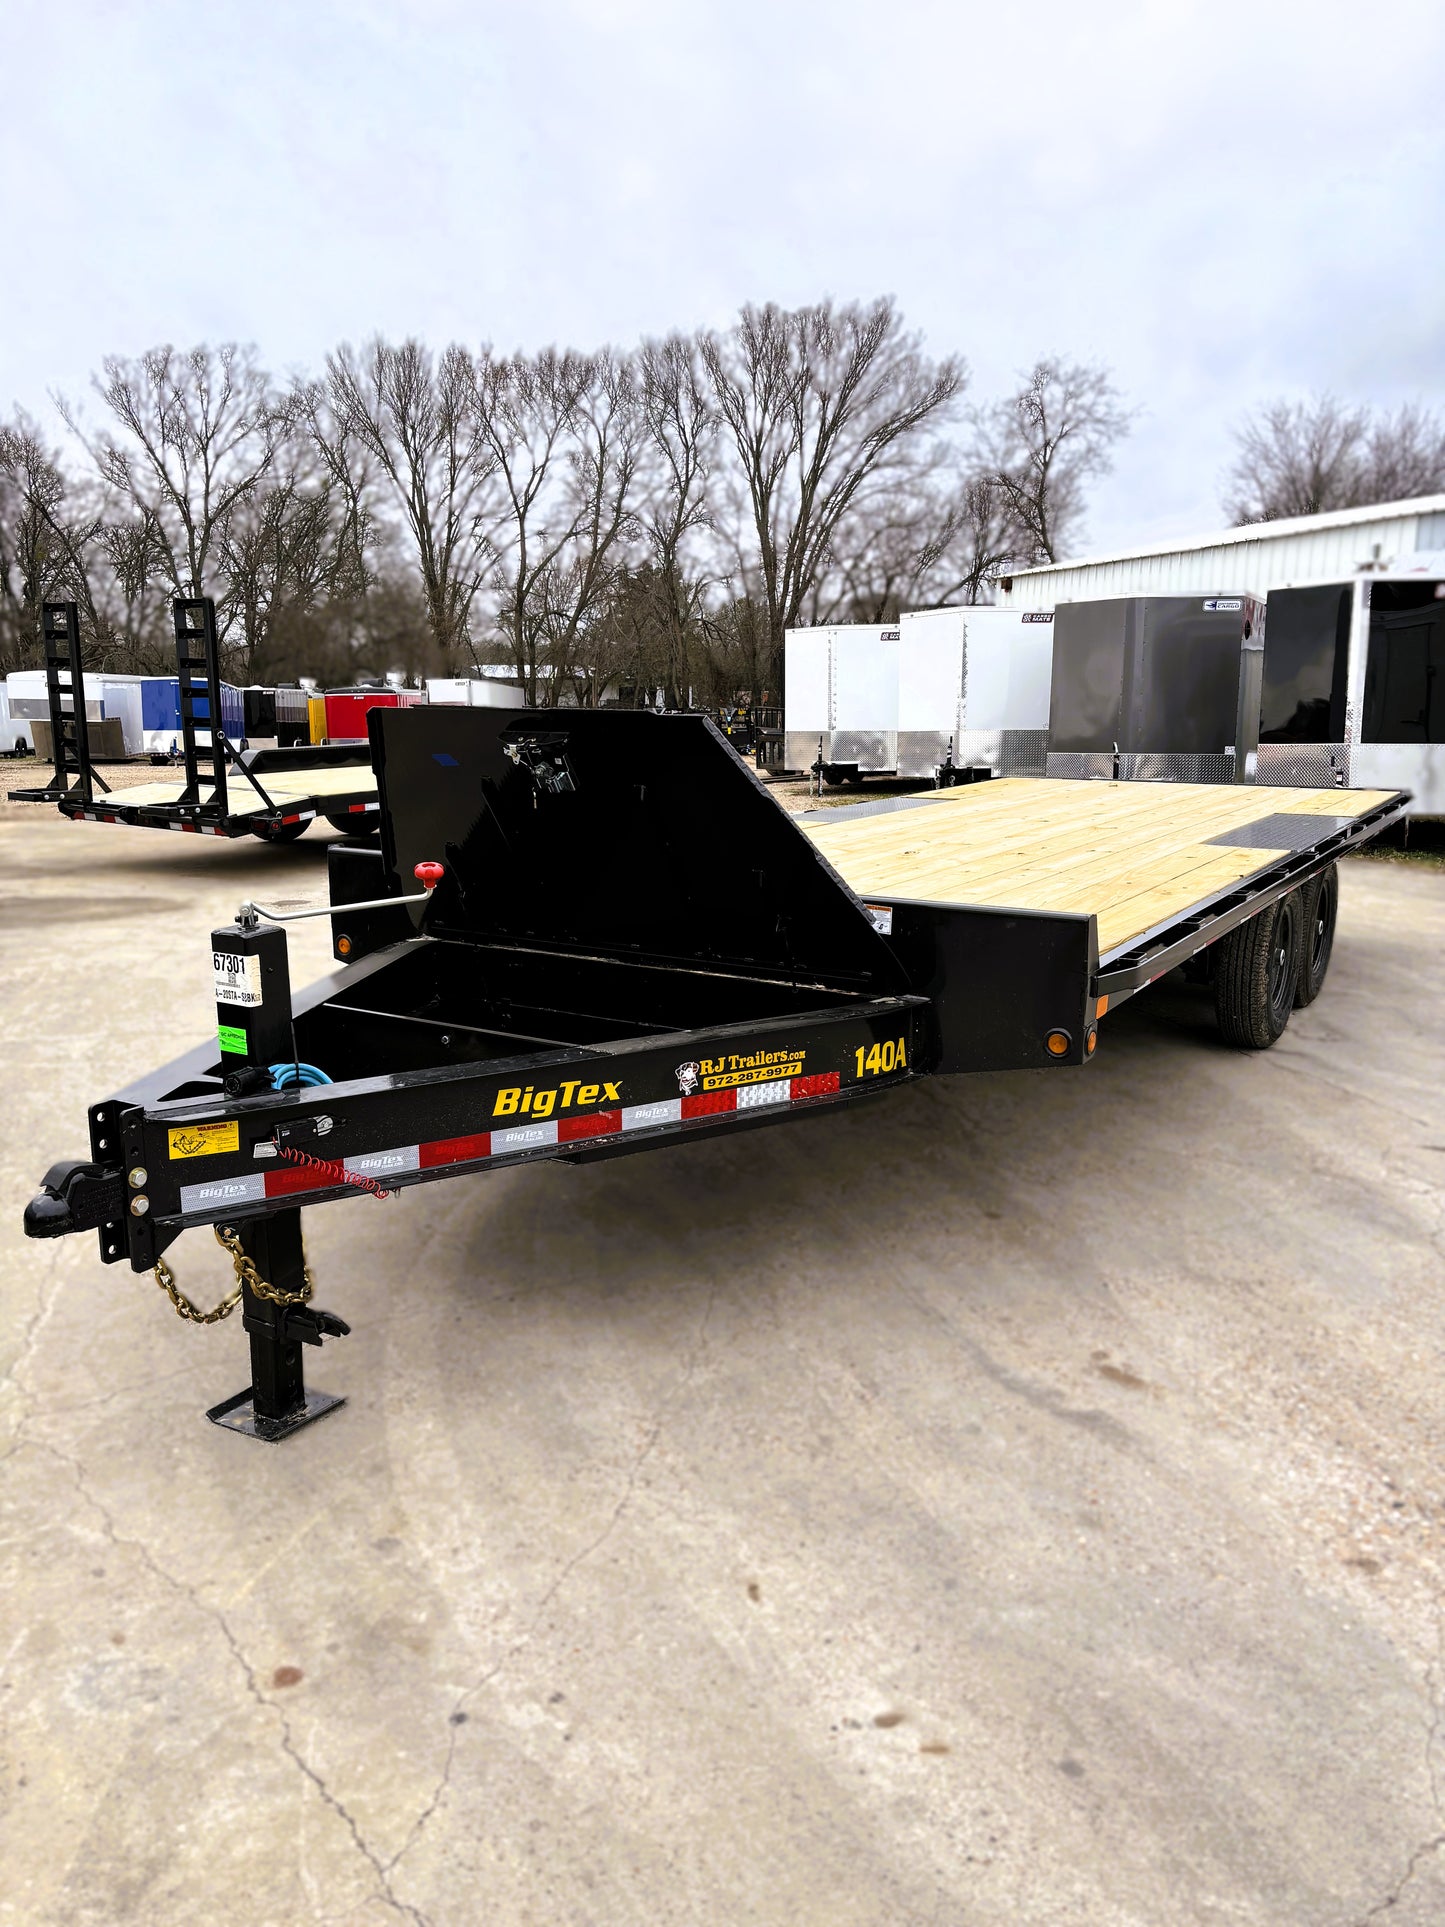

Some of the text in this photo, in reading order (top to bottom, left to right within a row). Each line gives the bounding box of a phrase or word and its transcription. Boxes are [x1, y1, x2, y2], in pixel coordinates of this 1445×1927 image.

[213, 953, 246, 974] 67301
[699, 1056, 727, 1076] RJ
[855, 1037, 907, 1078] 140A
[708, 1064, 798, 1087] 972-287-9977
[491, 1080, 624, 1119] BigTex
[635, 1107, 671, 1118] BigTex
[505, 1130, 544, 1141] BigTex
[361, 1155, 404, 1169] BigTex
[200, 1184, 247, 1198] BigTex
